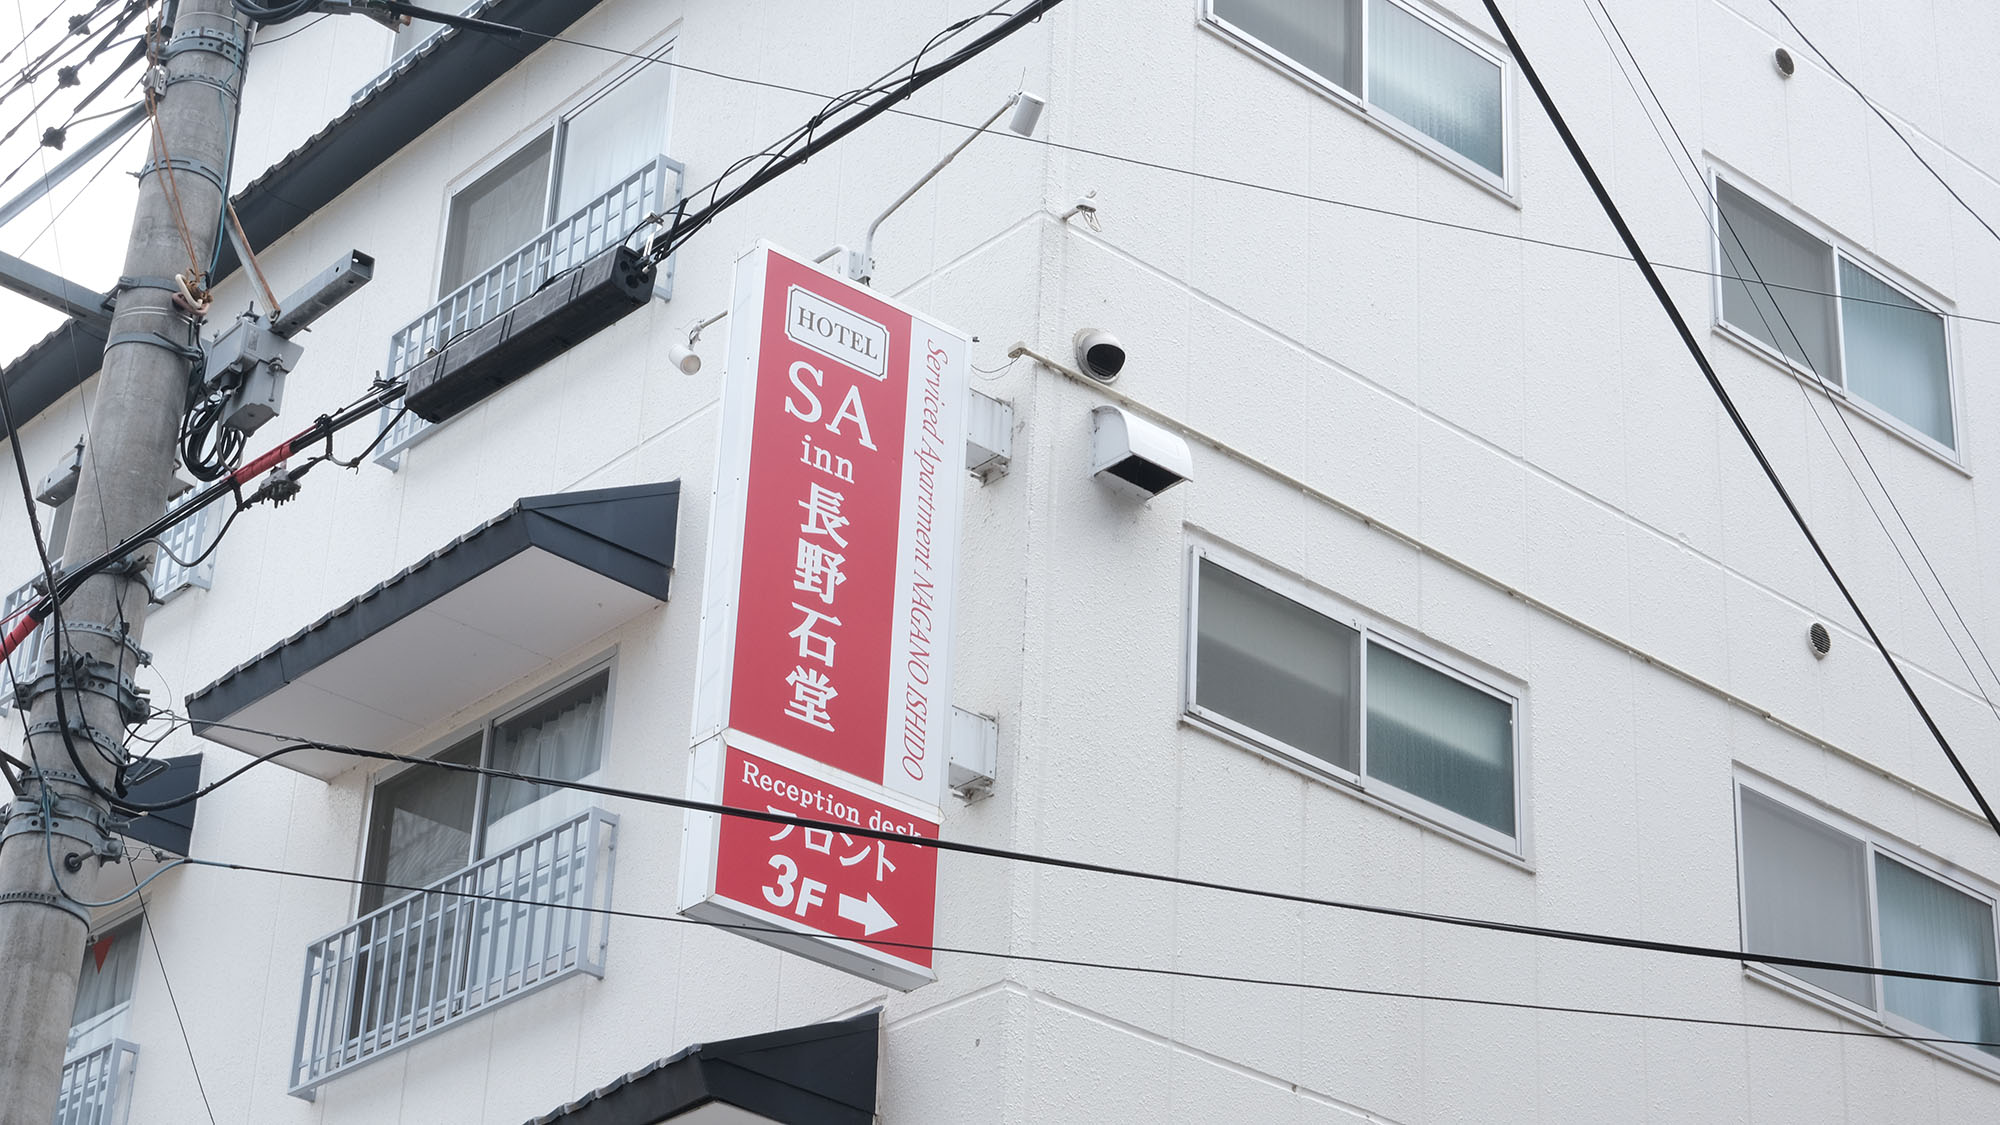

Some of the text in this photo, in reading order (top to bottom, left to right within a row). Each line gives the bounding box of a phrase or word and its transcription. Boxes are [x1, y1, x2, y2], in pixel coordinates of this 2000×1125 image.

[797, 306, 878, 360] HOTEL
[785, 360, 878, 452] SA
[800, 434, 855, 484] inn
[902, 338, 948, 781] Serviced Apartment NAGANO ISHIDO
[784, 481, 850, 732] 長野石堂
[742, 760, 860, 825] Reception
[766, 805, 896, 882] フロント
[762, 854, 828, 917] 3F
